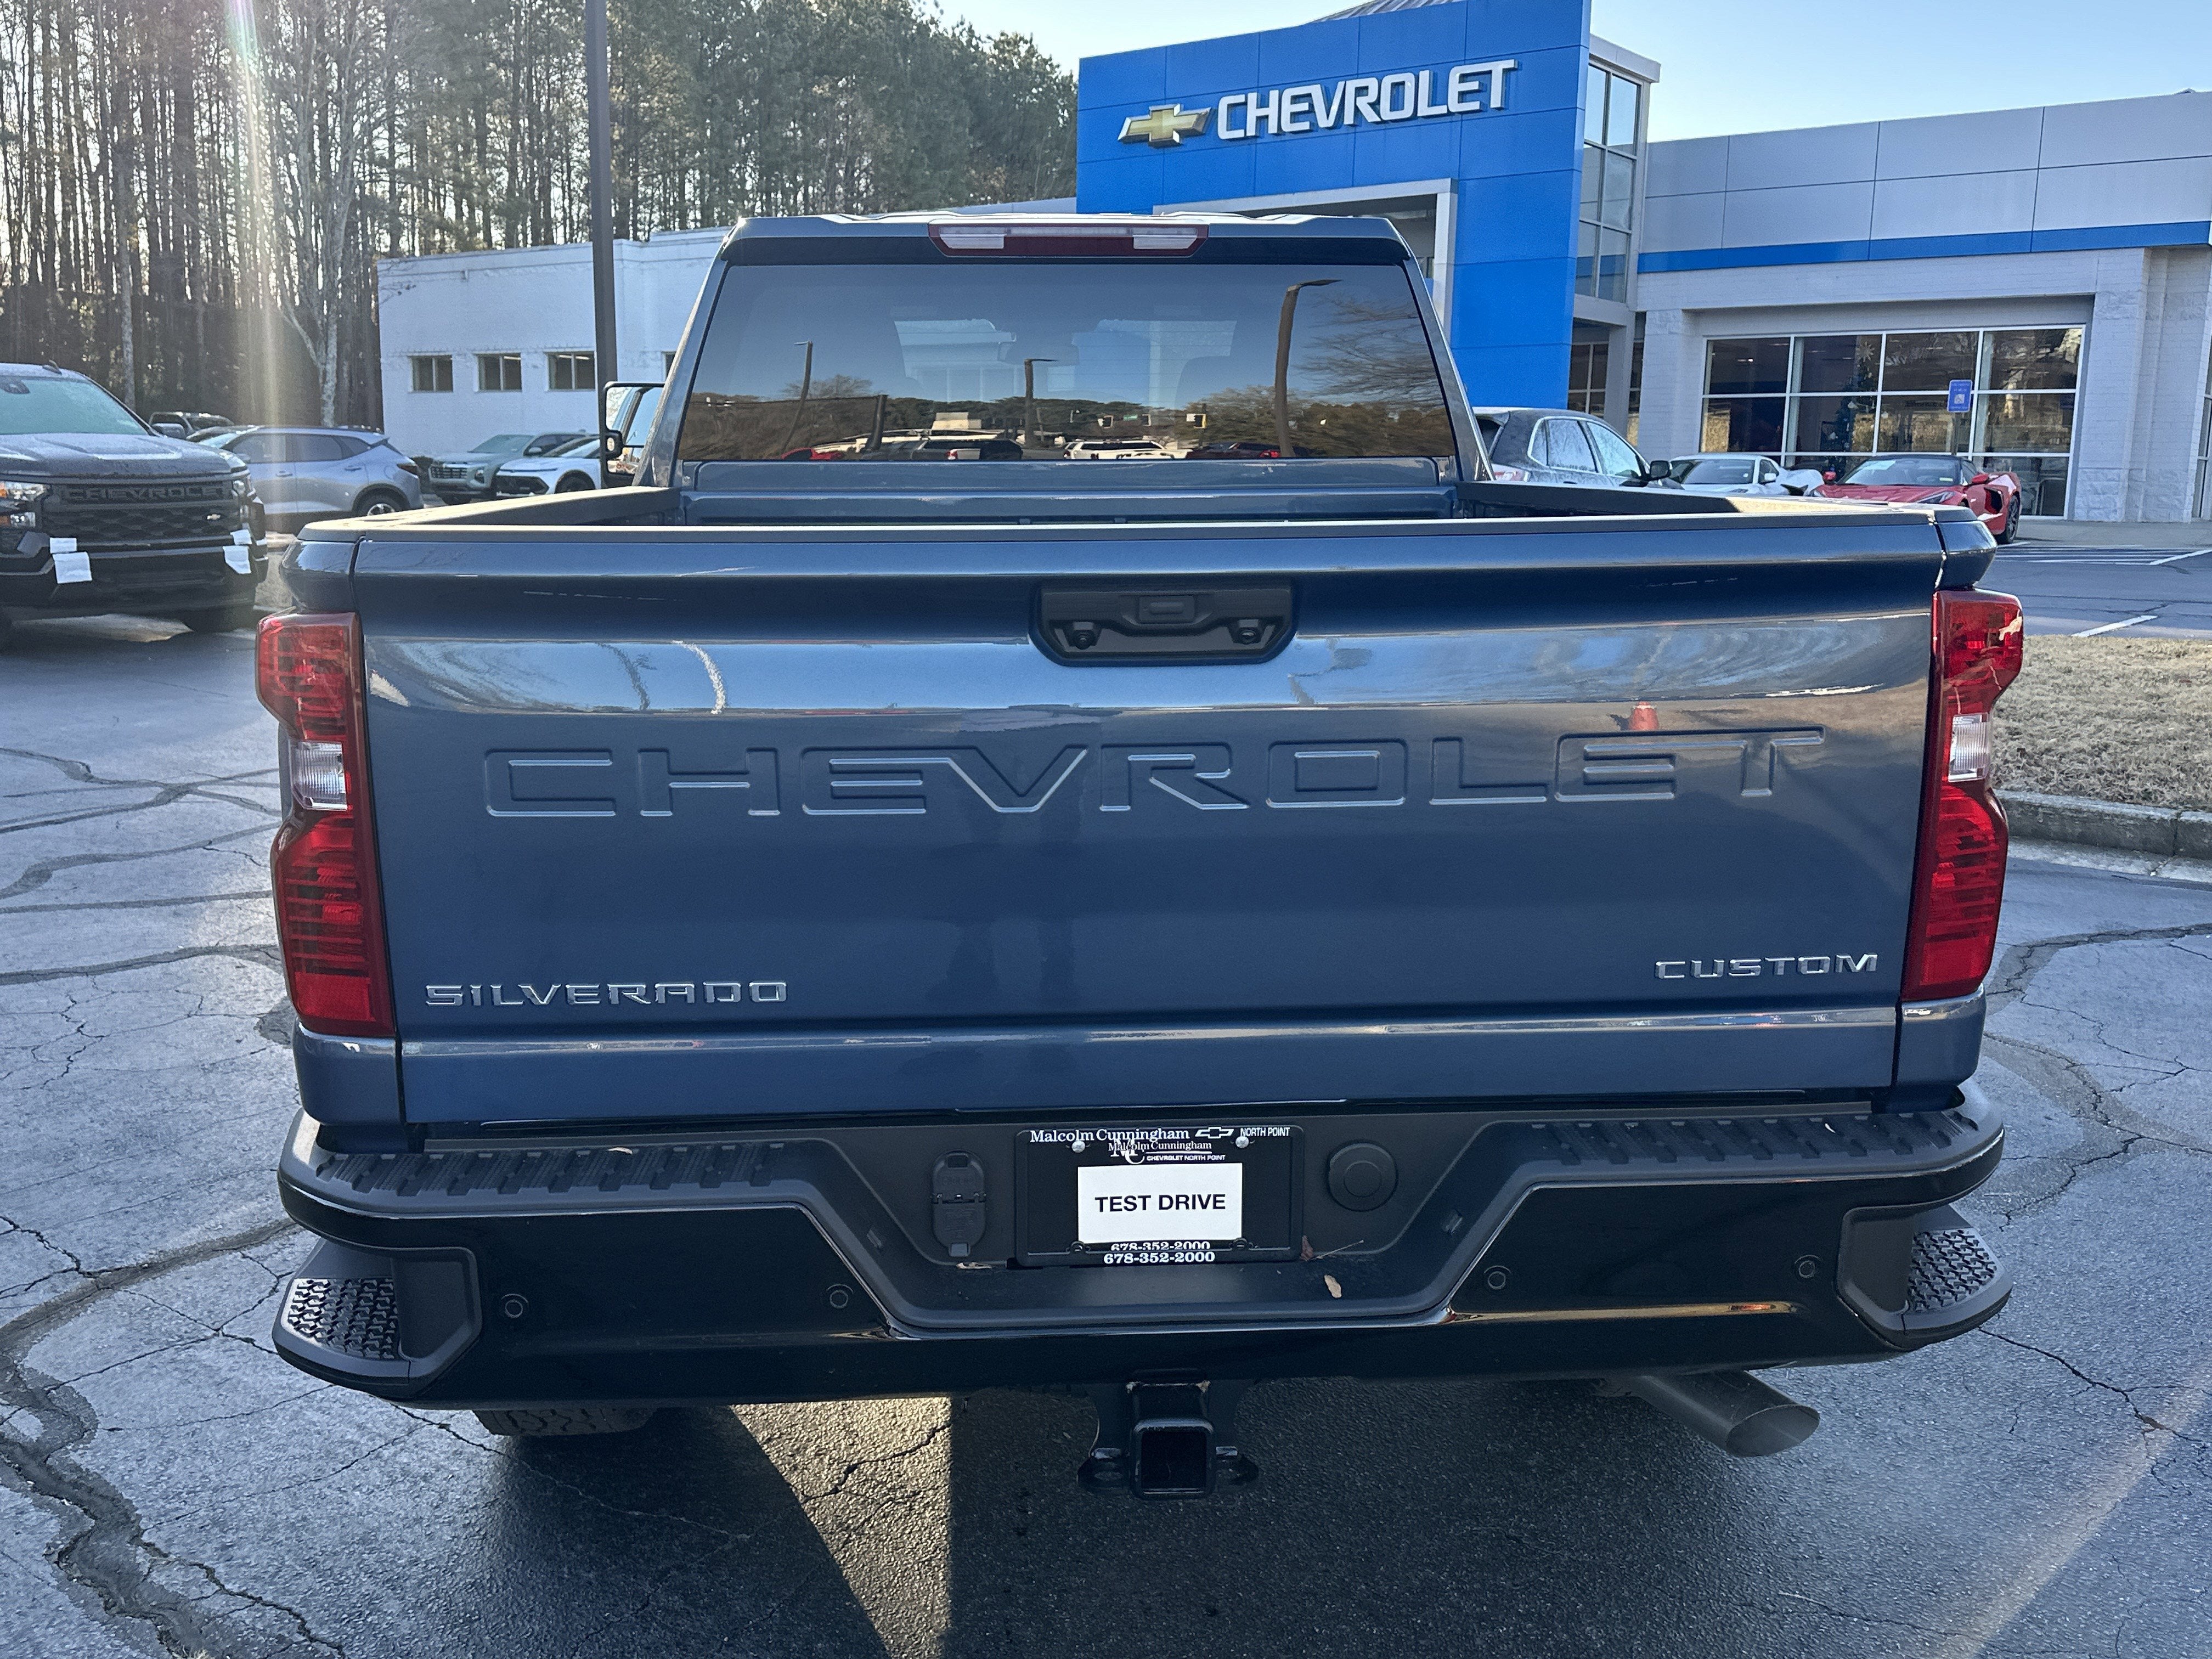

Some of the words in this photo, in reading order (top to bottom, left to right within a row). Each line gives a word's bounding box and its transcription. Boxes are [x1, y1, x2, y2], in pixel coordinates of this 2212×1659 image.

[1216, 59, 1519, 140] CHEVROLET
[485, 725, 1826, 819] CHEVROLET
[1654, 953, 1878, 979] CUSTOM
[425, 981, 787, 1006] SILVERADO
[1030, 1128, 1094, 1143] Malcolm
[1096, 1127, 1190, 1142] Cunningham
[1240, 1127, 1266, 1137] NORTH
[1267, 1127, 1290, 1137] POINT
[1108, 1141, 1150, 1152] Malcolm
[1150, 1141, 1212, 1151] Cunningham
[1094, 1195, 1152, 1212] TEST
[1159, 1194, 1226, 1210] DRIVE
[1110, 1240, 1211, 1251] 678-352-2000
[1103, 1251, 1216, 1265] 678-352-2000
